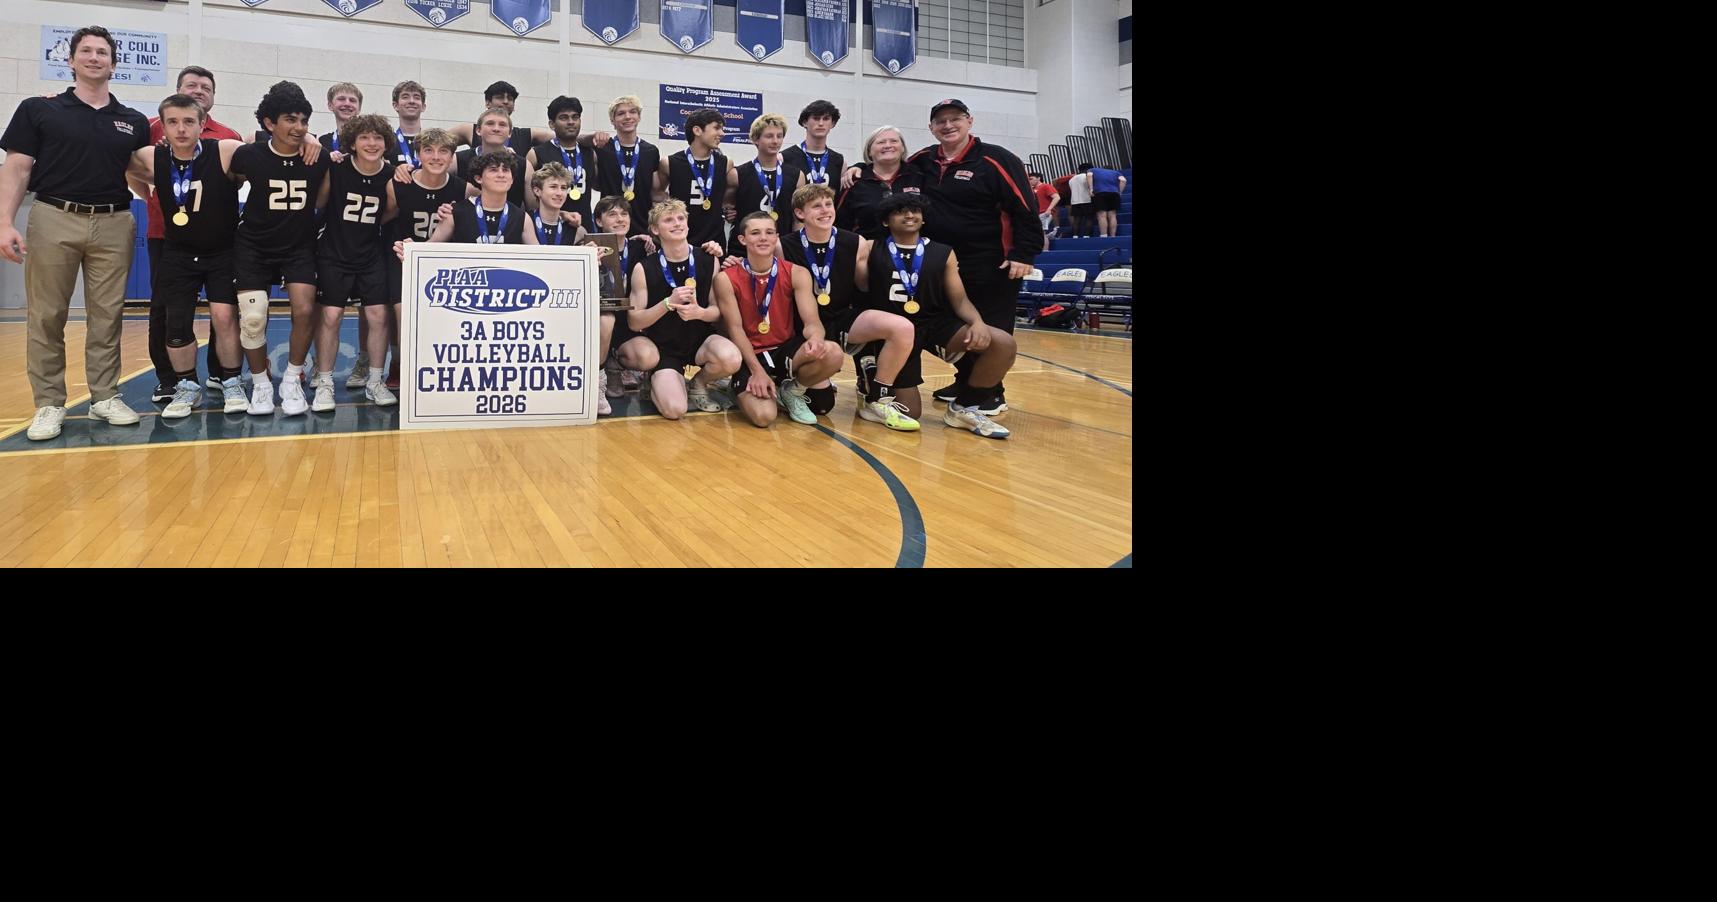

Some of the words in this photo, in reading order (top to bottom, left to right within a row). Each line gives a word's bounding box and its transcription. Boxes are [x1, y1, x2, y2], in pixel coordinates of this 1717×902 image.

[128, 41, 159, 53] COLD
[136, 55, 161, 66] INC.
[665, 86, 685, 94] Quality
[686, 87, 709, 96] Program
[710, 89, 740, 98] Assessment
[741, 92, 757, 100] Award
[269, 179, 307, 210] 25
[343, 192, 380, 224] 22
[435, 269, 488, 286] PIAA
[1056, 270, 1083, 278] EAGLES
[430, 288, 546, 308] DISTRICT
[549, 289, 581, 308] III
[460, 321, 487, 341] 3A
[493, 321, 545, 341] BOYS
[433, 343, 570, 364] VOLLEYBALL
[418, 366, 582, 392] CHAMPIONS
[475, 395, 527, 414] 2026
